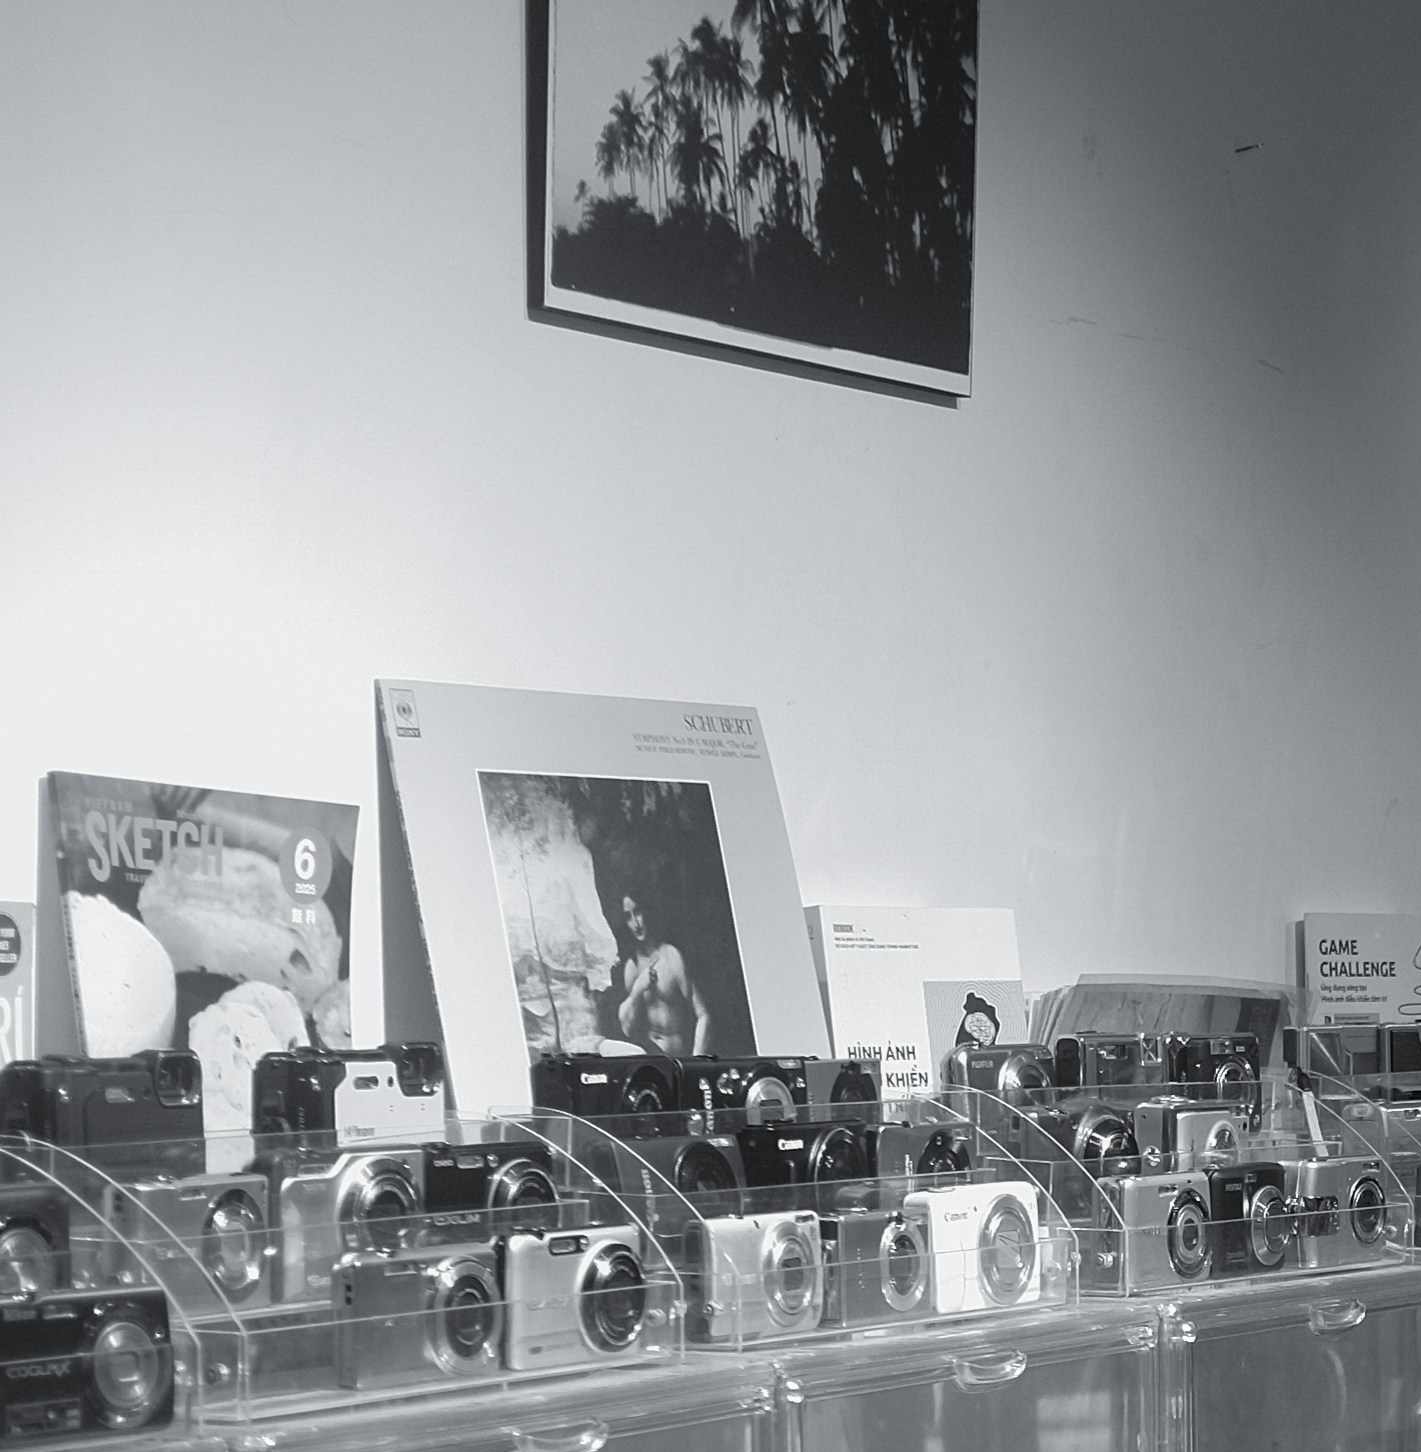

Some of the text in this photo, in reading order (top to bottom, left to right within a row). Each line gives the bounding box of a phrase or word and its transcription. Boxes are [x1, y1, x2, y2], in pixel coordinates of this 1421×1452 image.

[683, 714, 753, 735] SCHUBERT
[84, 810, 224, 883] SKETCH
[294, 838, 316, 880] 6
[1319, 939, 1359, 955] GAME
[1320, 961, 1397, 977] CHALLENGE
[847, 1040, 916, 1061] HÌNH ẢNH
[886, 1064, 929, 1088] KHIỂN
[6, 1361, 71, 1379] COOLPIX
